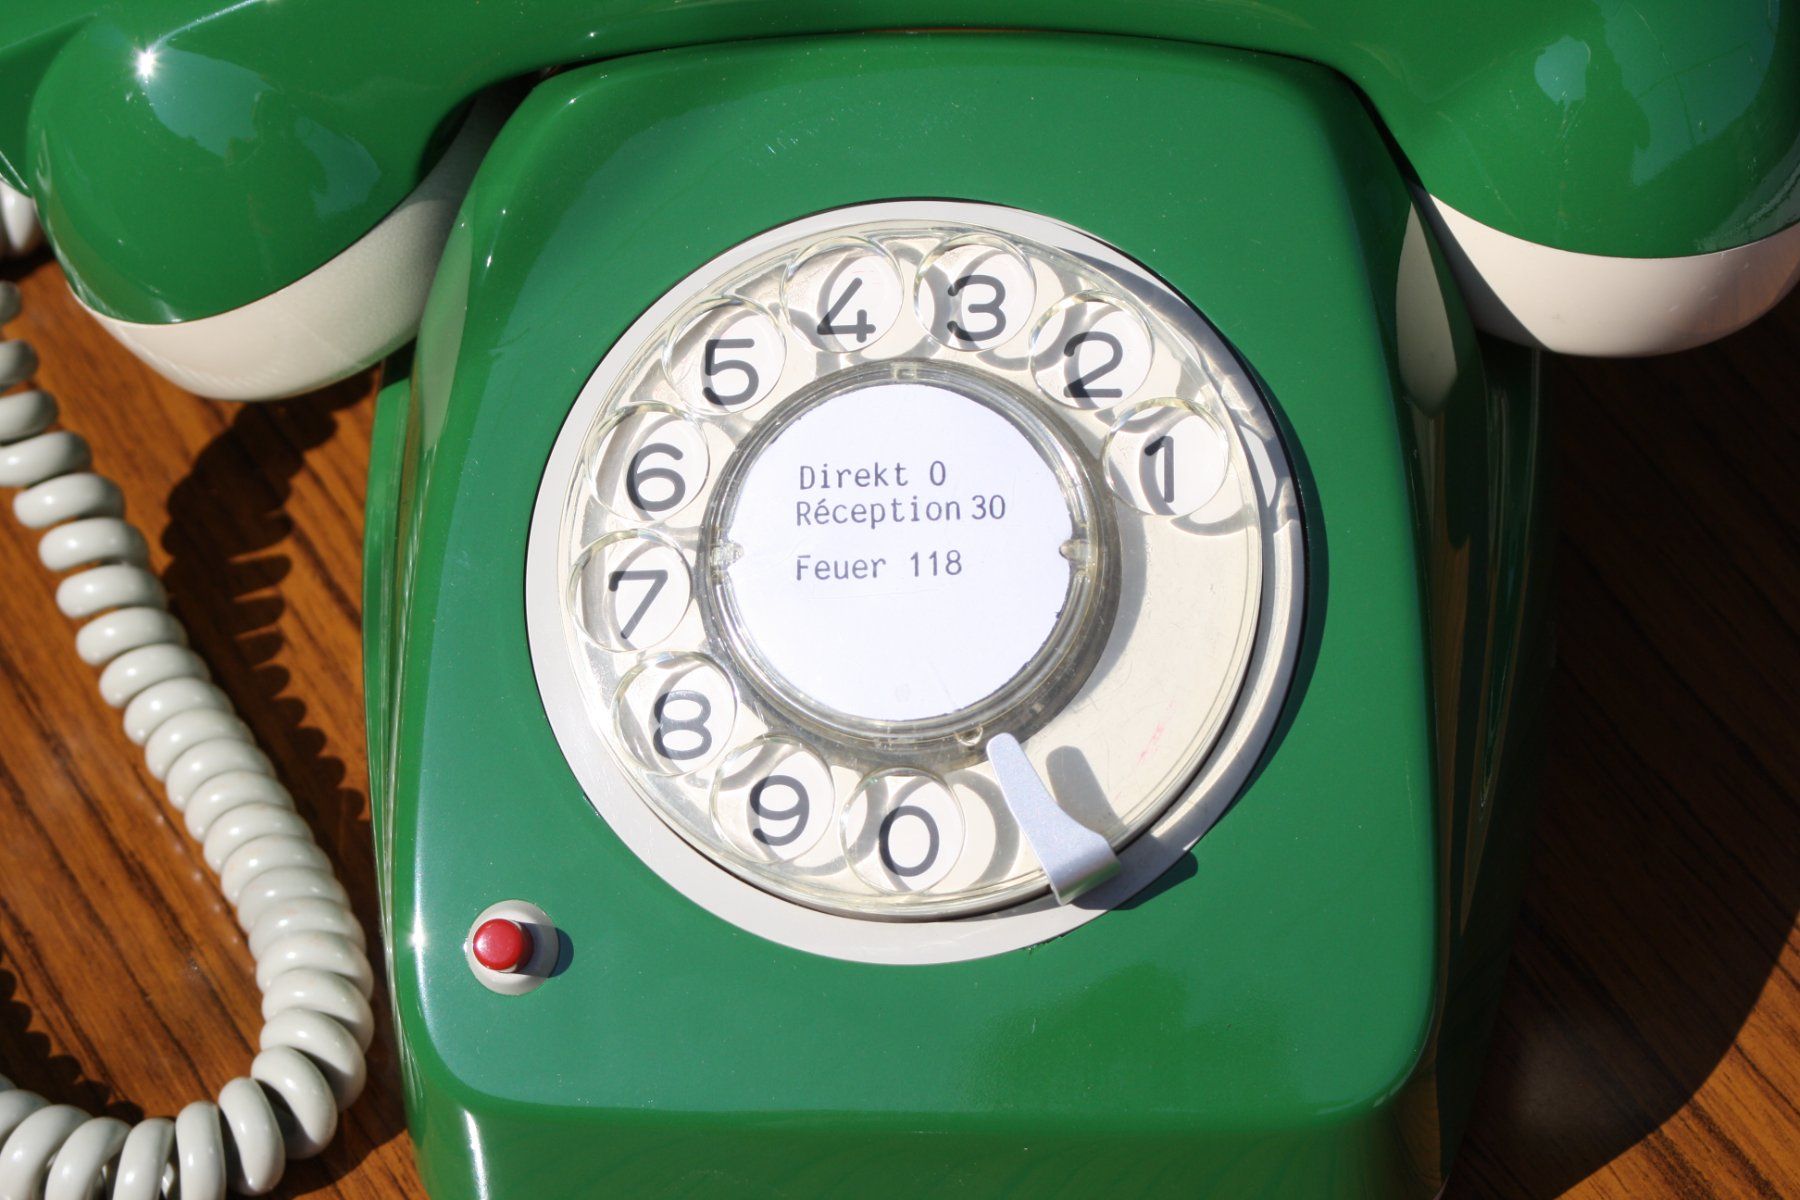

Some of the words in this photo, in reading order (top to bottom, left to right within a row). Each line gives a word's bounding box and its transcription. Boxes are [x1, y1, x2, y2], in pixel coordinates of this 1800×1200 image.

[816, 277, 876, 343] 4
[947, 274, 1006, 342] 3
[702, 338, 759, 405] 5
[1063, 331, 1123, 398] 2
[626, 443, 686, 512] 6
[799, 461, 909, 490] Direkt
[929, 460, 946, 487] 0
[1144, 436, 1175, 503] 1
[796, 495, 961, 530] Réception
[971, 494, 1006, 520] 30
[796, 554, 887, 581] Feuer
[910, 549, 963, 577] 118
[608, 569, 668, 639] 7
[653, 690, 712, 760] 8
[749, 775, 809, 846] 9
[879, 805, 940, 877] 0
